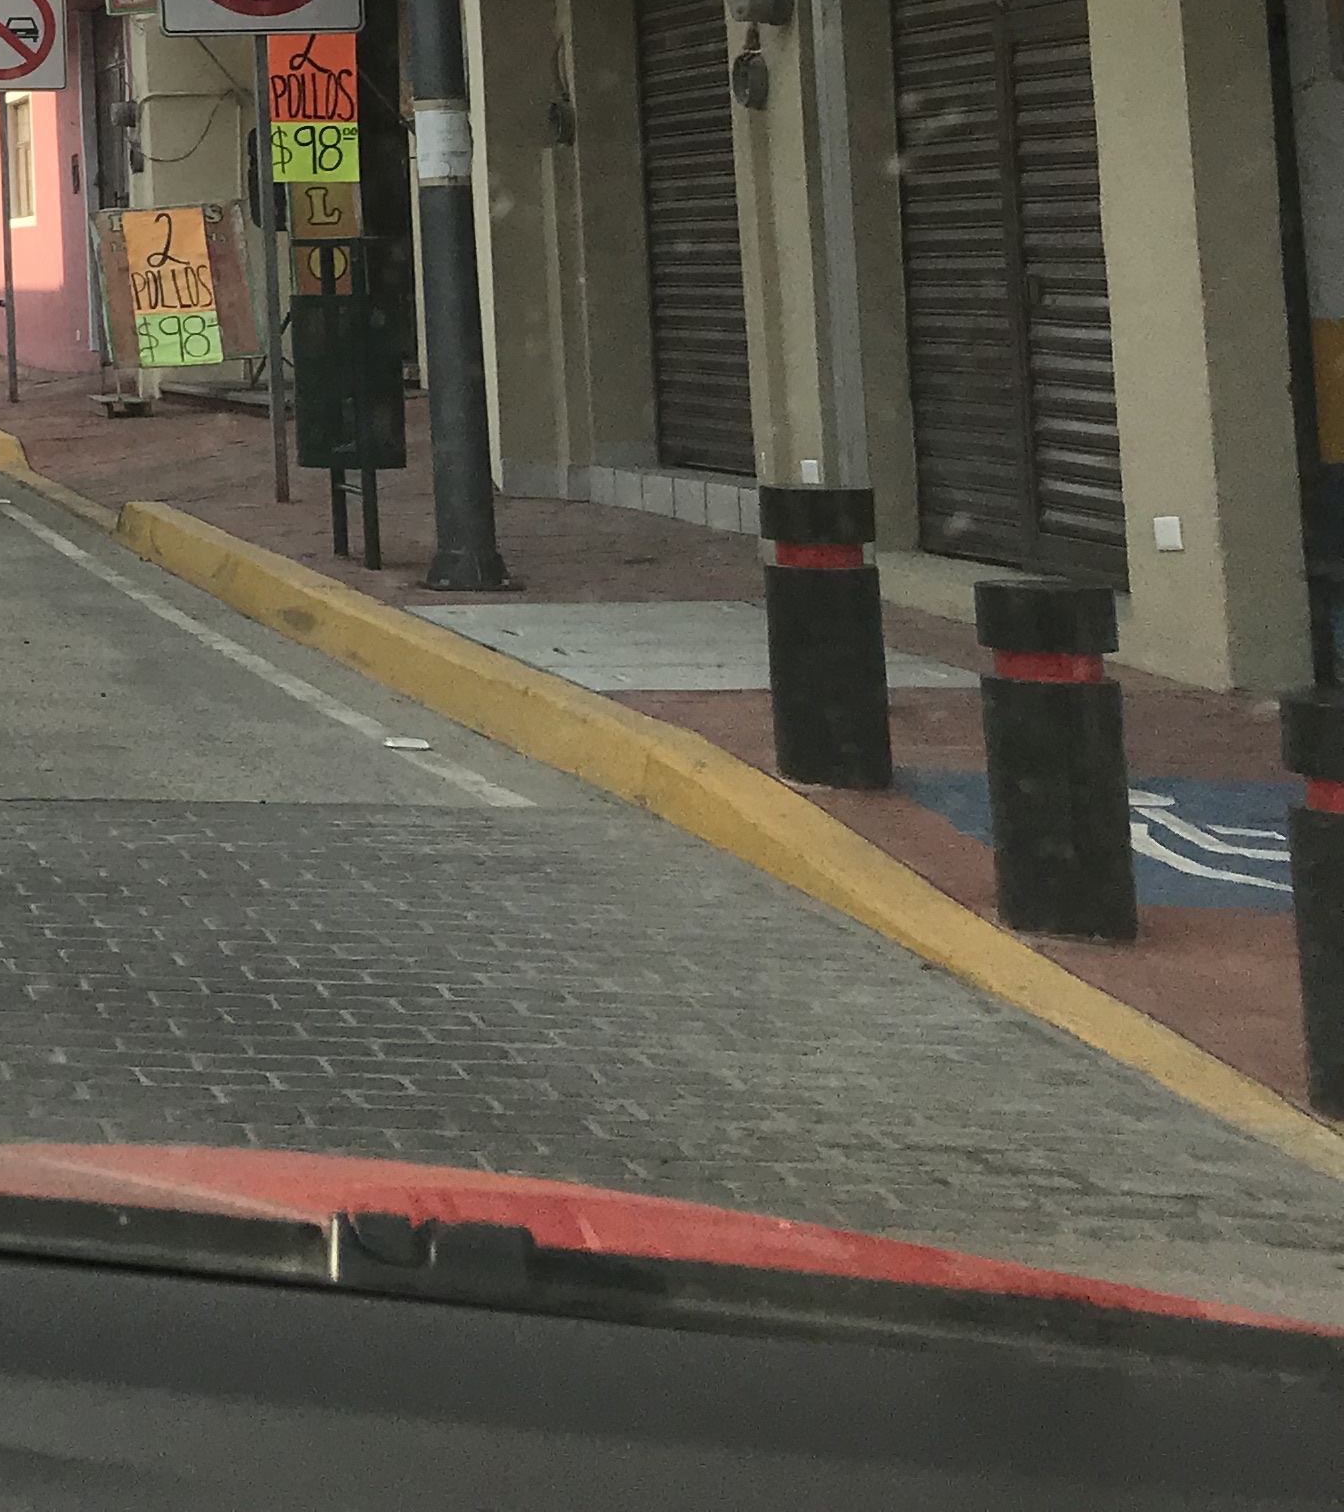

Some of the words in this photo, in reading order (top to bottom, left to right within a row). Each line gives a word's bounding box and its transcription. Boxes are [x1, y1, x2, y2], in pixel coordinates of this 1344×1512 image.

[270, 68, 355, 123] POLLOS
[146, 212, 191, 268] 2
[130, 263, 214, 311] POLLOS
